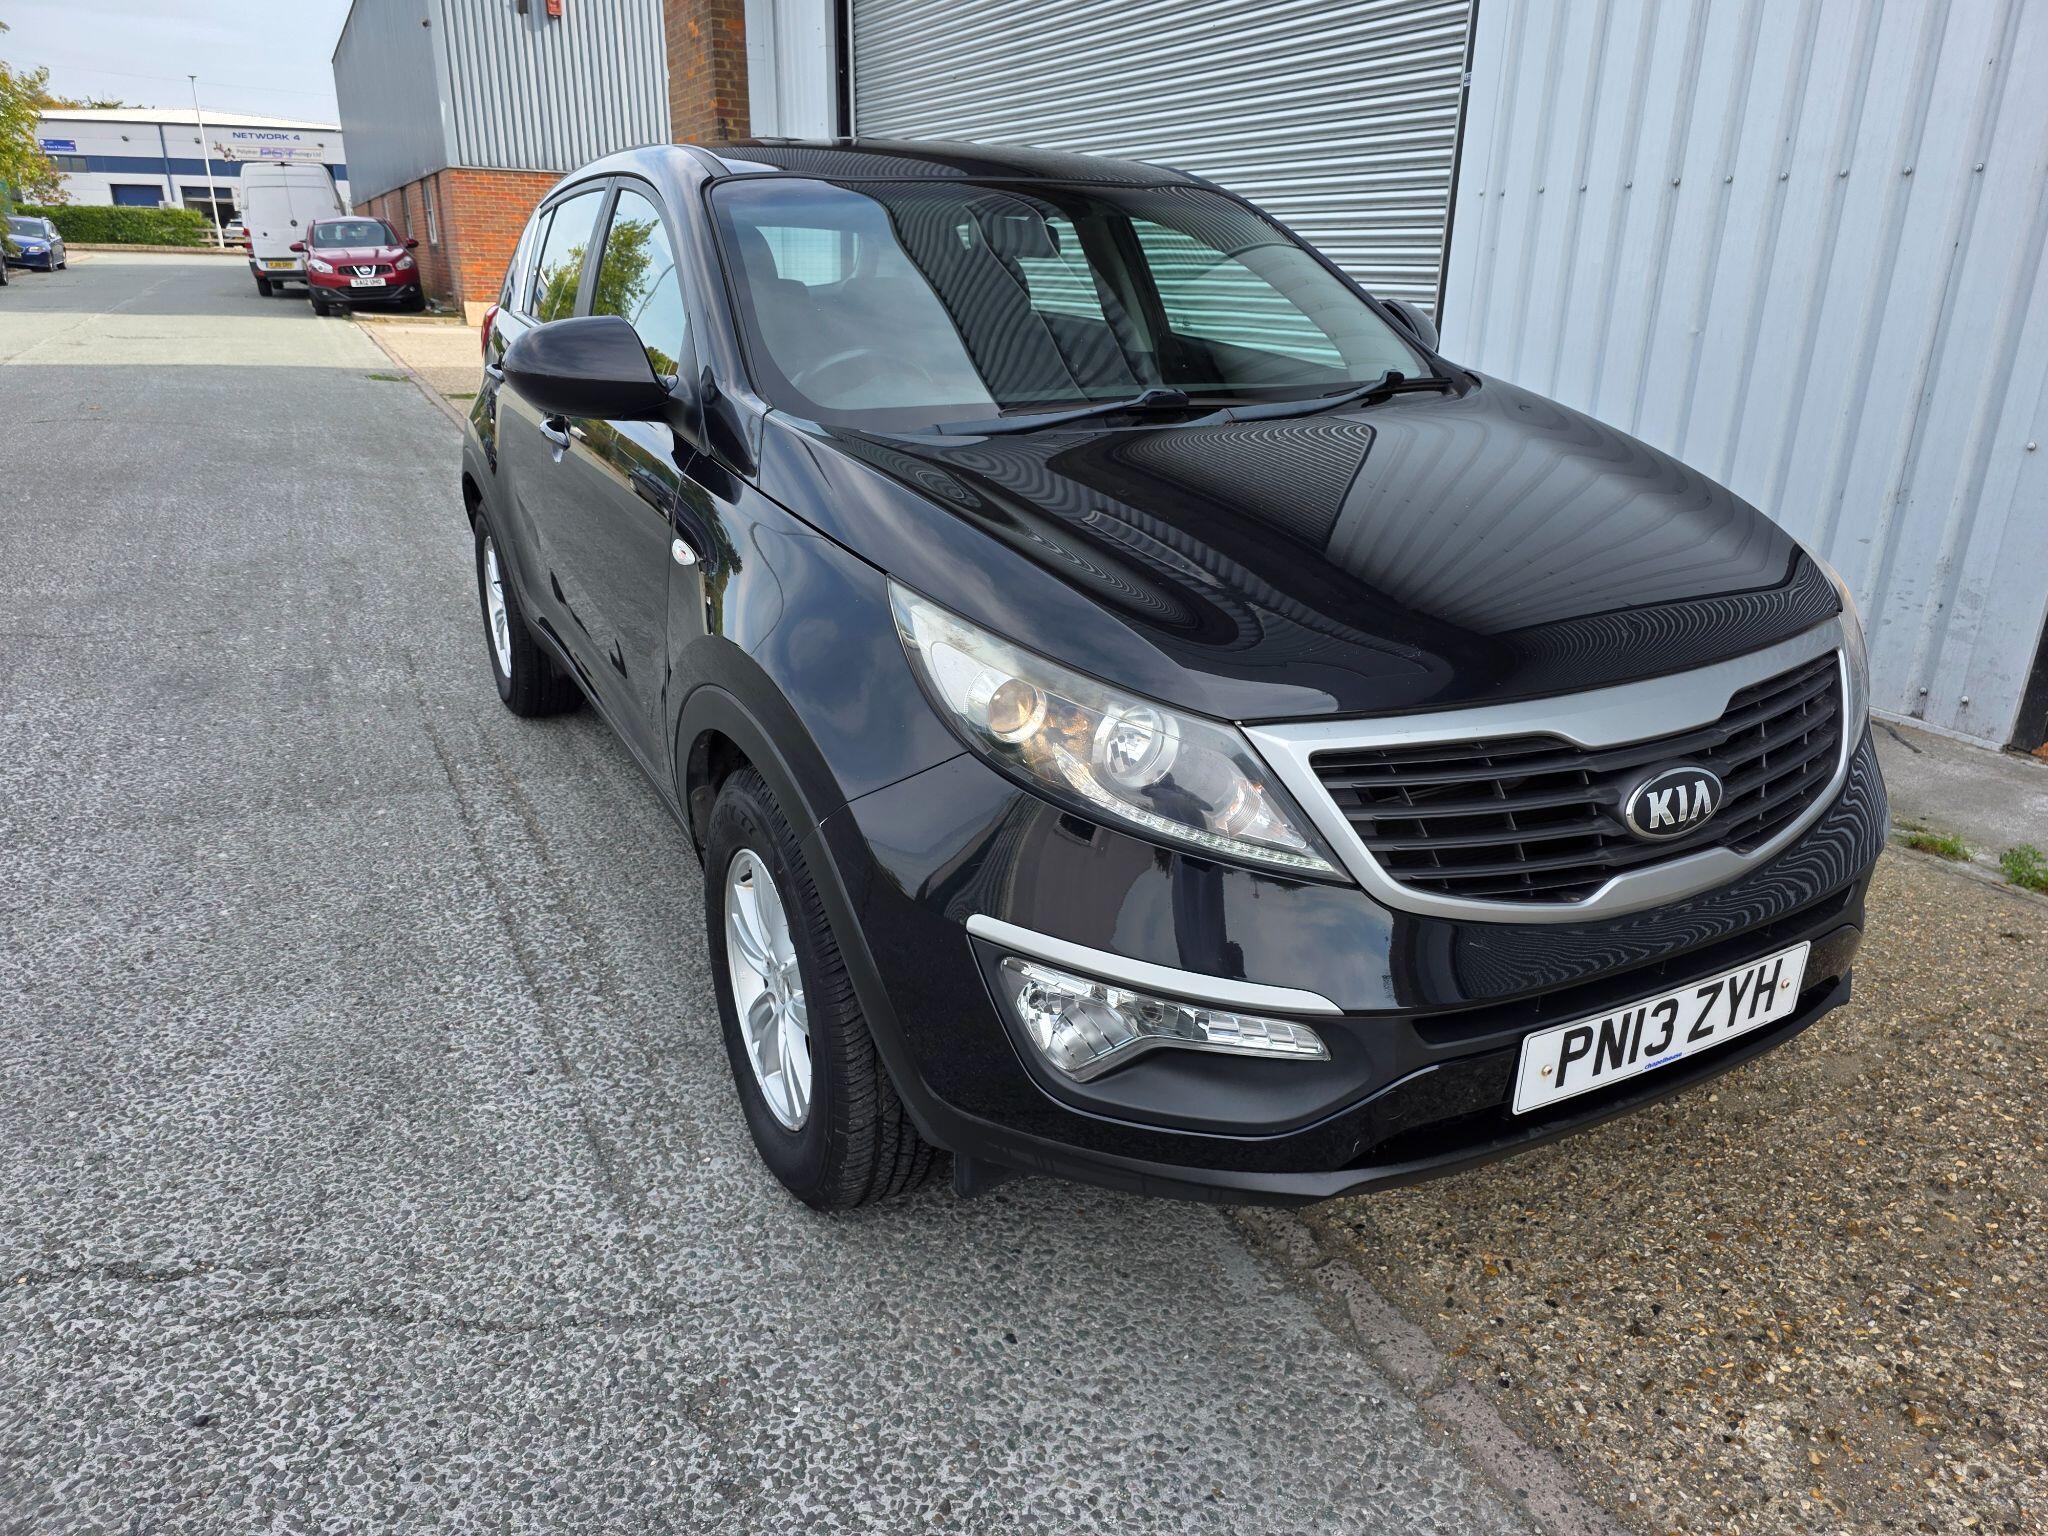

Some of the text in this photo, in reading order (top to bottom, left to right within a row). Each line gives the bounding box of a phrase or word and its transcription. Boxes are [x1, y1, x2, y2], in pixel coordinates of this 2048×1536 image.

[233, 132, 289, 141] NETWORK
[1647, 780, 1711, 829] KIA
[1555, 958, 1783, 1088] PN13 ZYH
